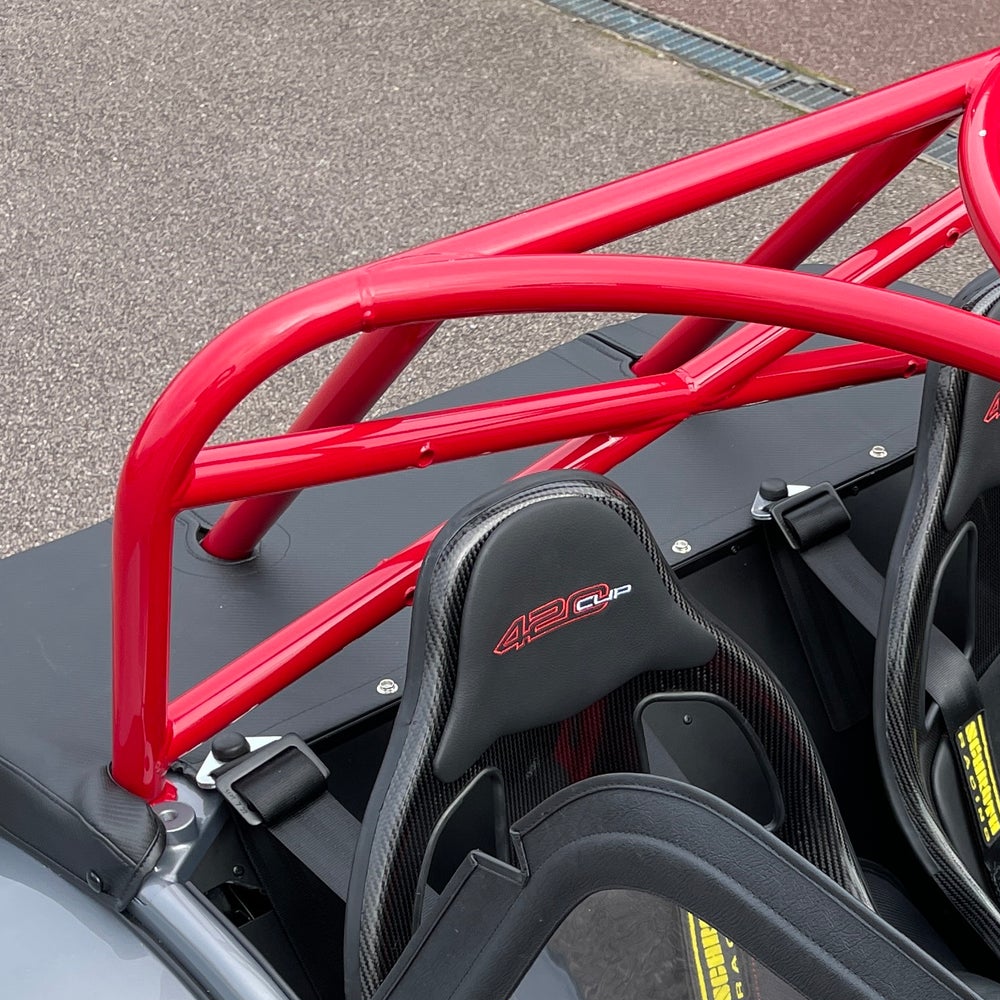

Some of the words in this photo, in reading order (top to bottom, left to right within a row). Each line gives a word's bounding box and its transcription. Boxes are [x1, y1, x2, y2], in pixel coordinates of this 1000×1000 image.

[493, 583, 610, 655] 420
[576, 584, 632, 614] CUP
[957, 731, 991, 842] RACING
